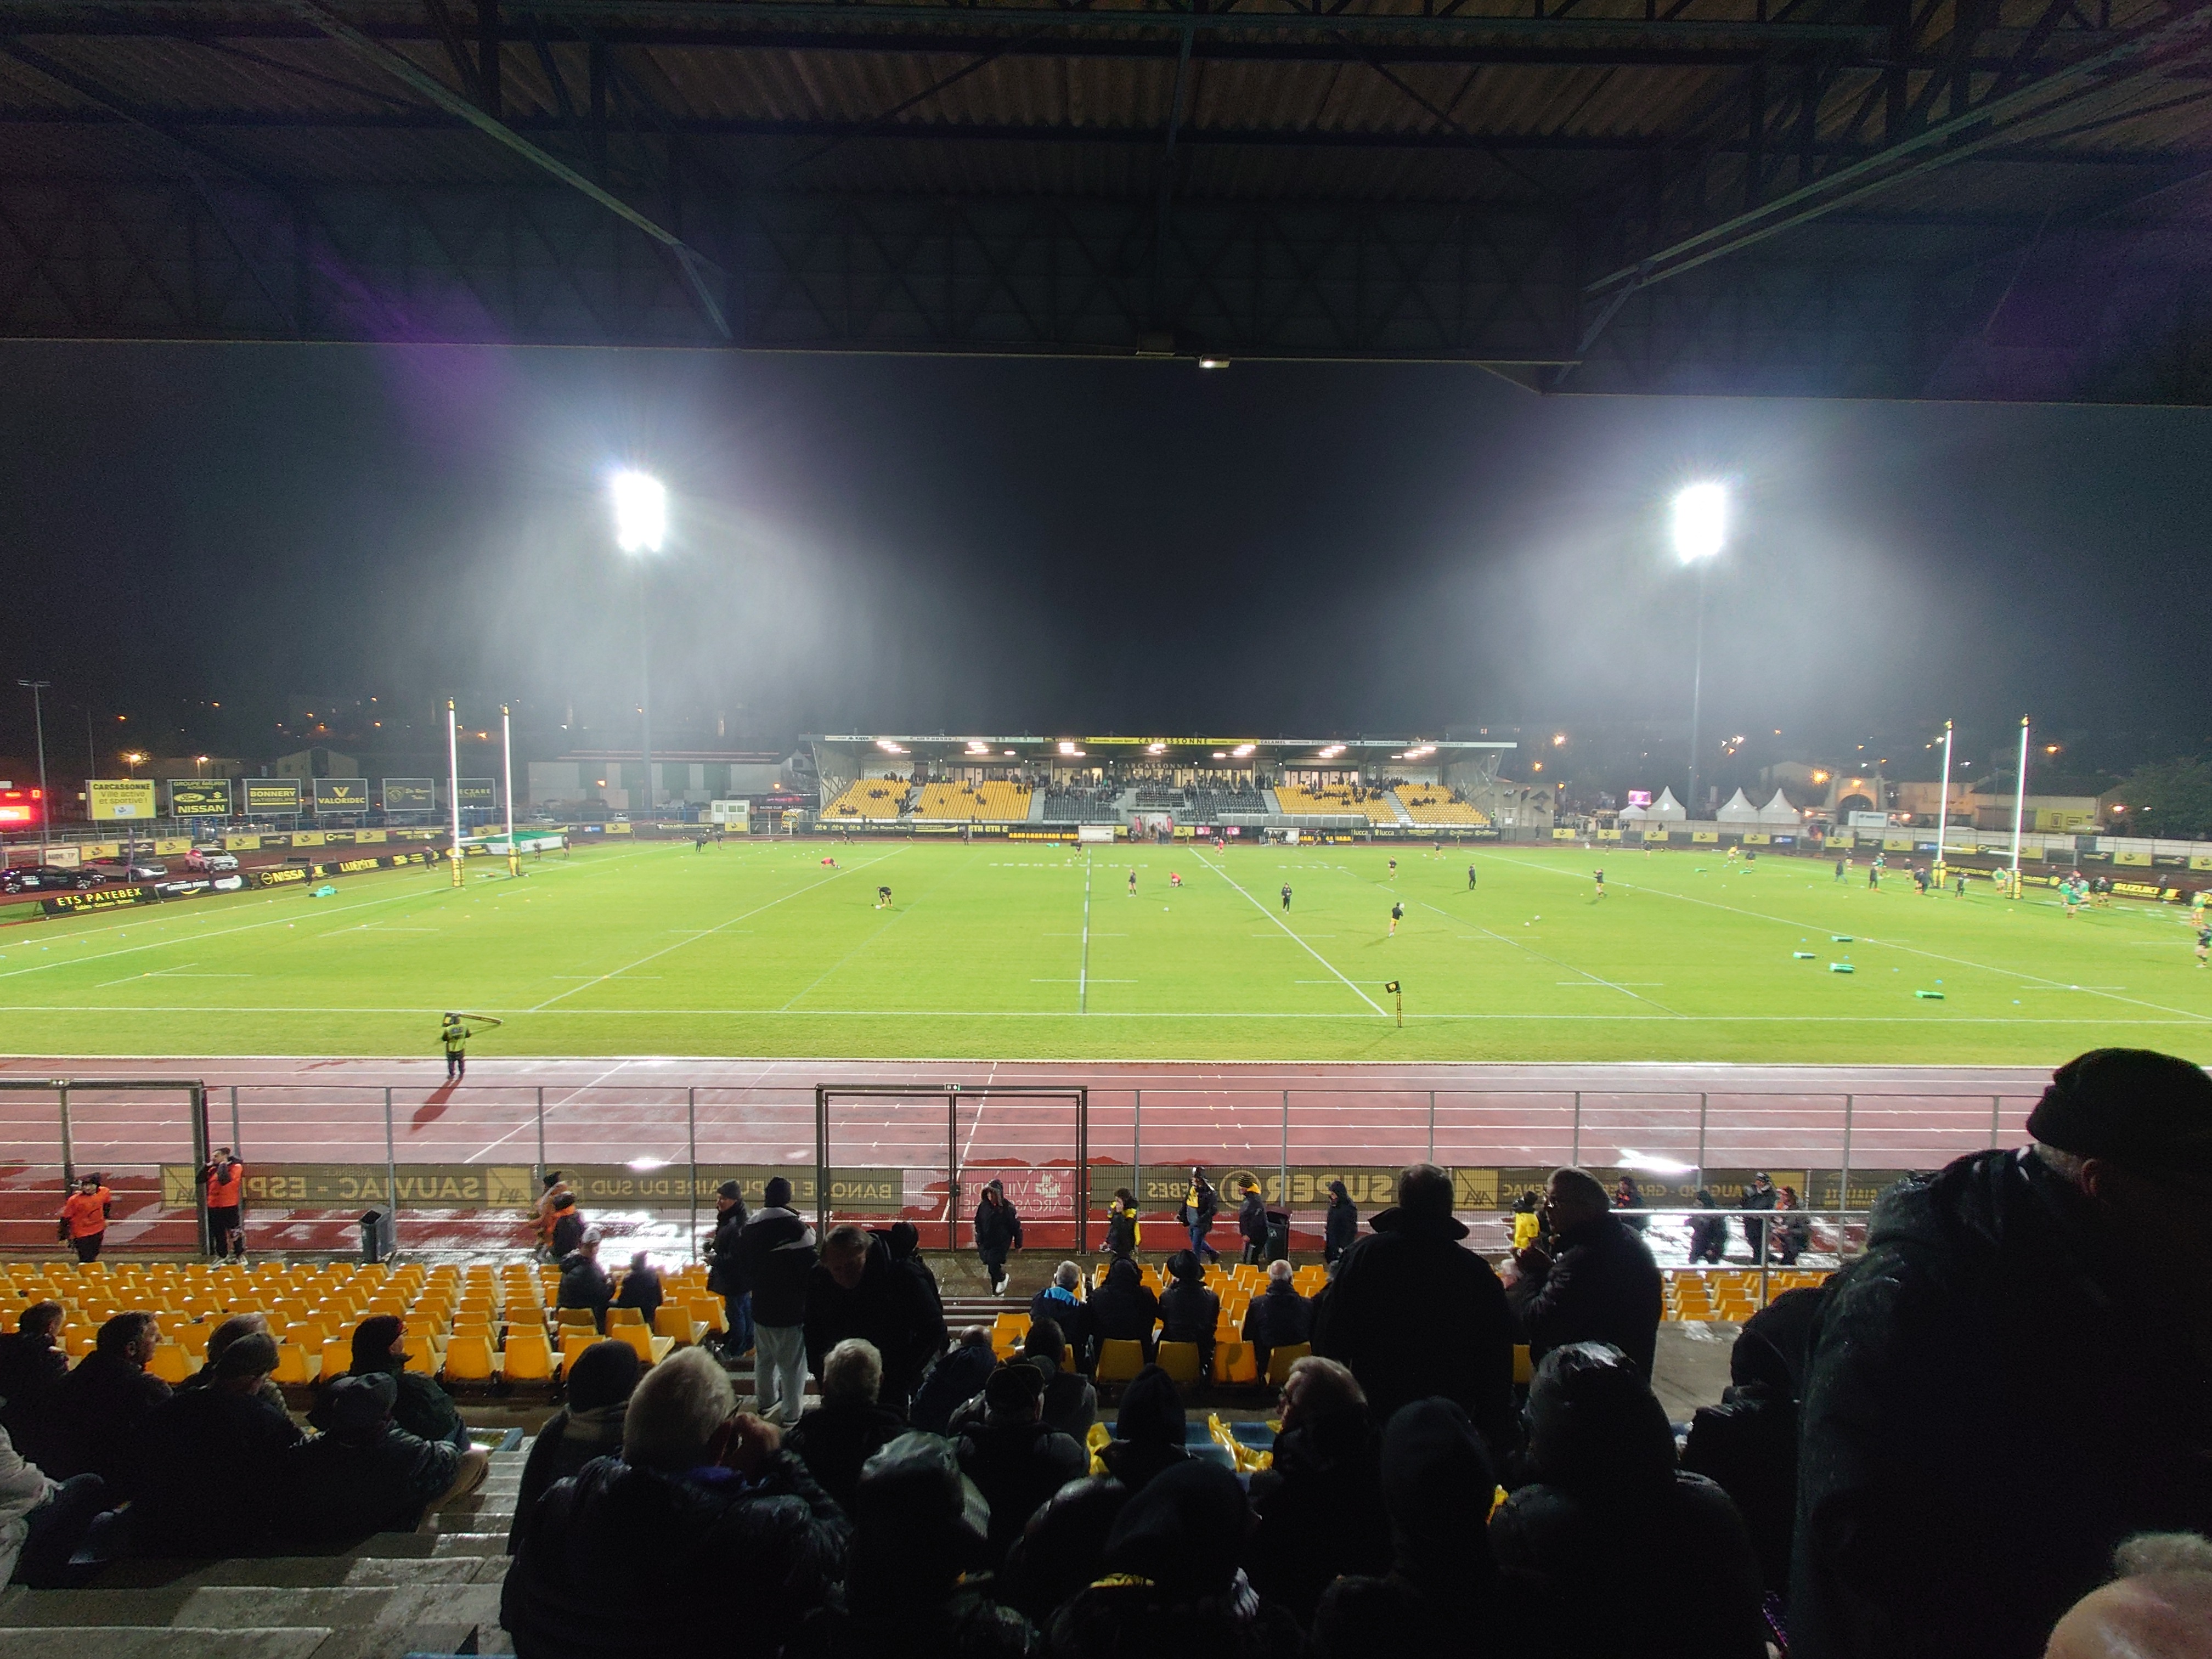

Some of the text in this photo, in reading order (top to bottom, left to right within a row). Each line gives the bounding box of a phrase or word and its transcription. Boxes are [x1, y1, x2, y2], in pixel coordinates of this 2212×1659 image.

[177, 804, 225, 813] NISSAN
[273, 868, 306, 882] NISSA
[2113, 883, 2160, 894] SUZUKI
[56, 895, 82, 906] ETS
[84, 888, 142, 902] PATEBEX
